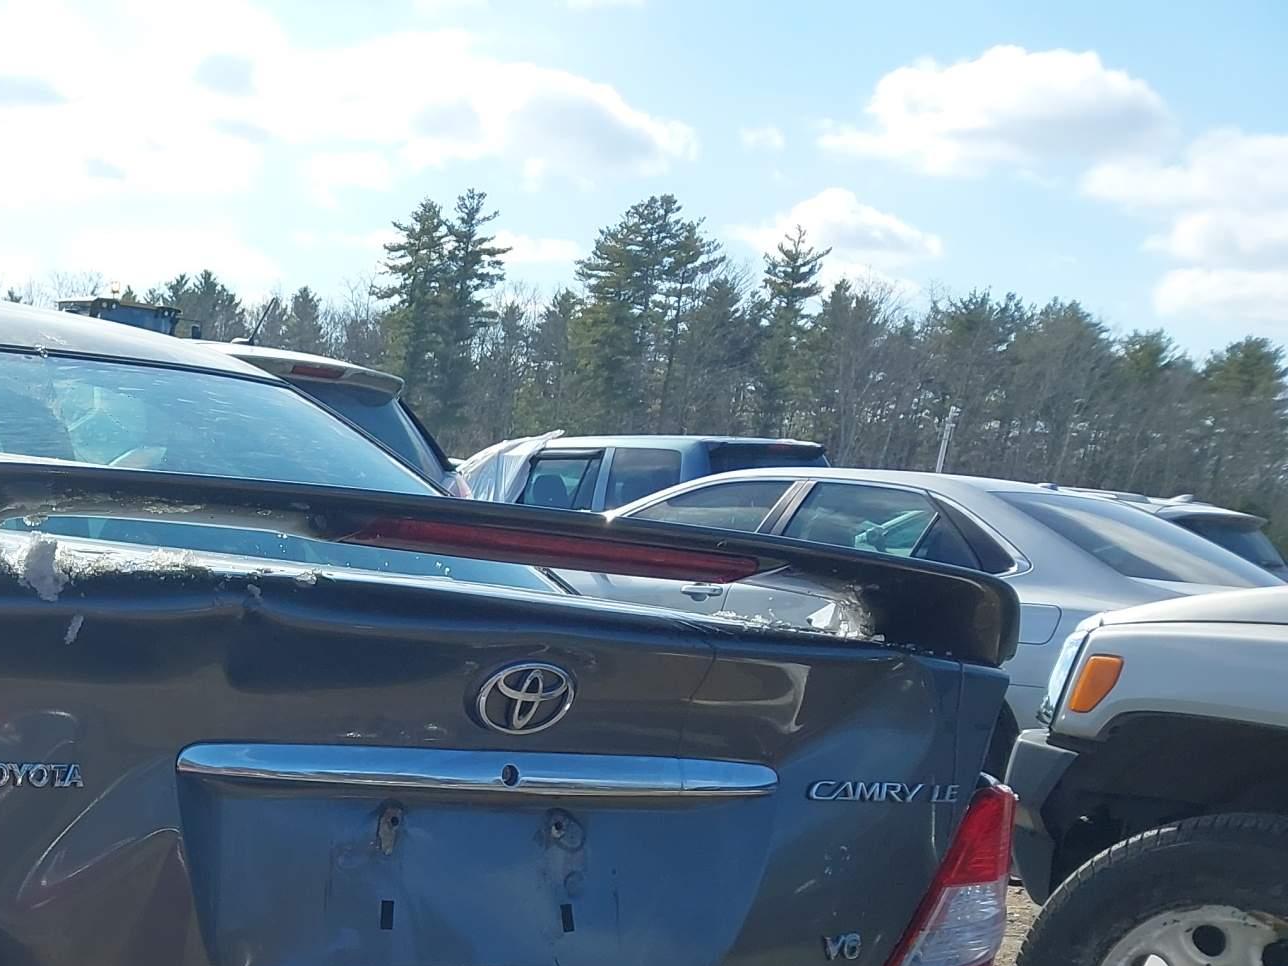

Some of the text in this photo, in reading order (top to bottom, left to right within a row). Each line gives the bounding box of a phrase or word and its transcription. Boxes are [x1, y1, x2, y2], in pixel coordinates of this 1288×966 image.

[809, 780, 960, 802] CAMRY LE
[823, 933, 861, 960] V6
